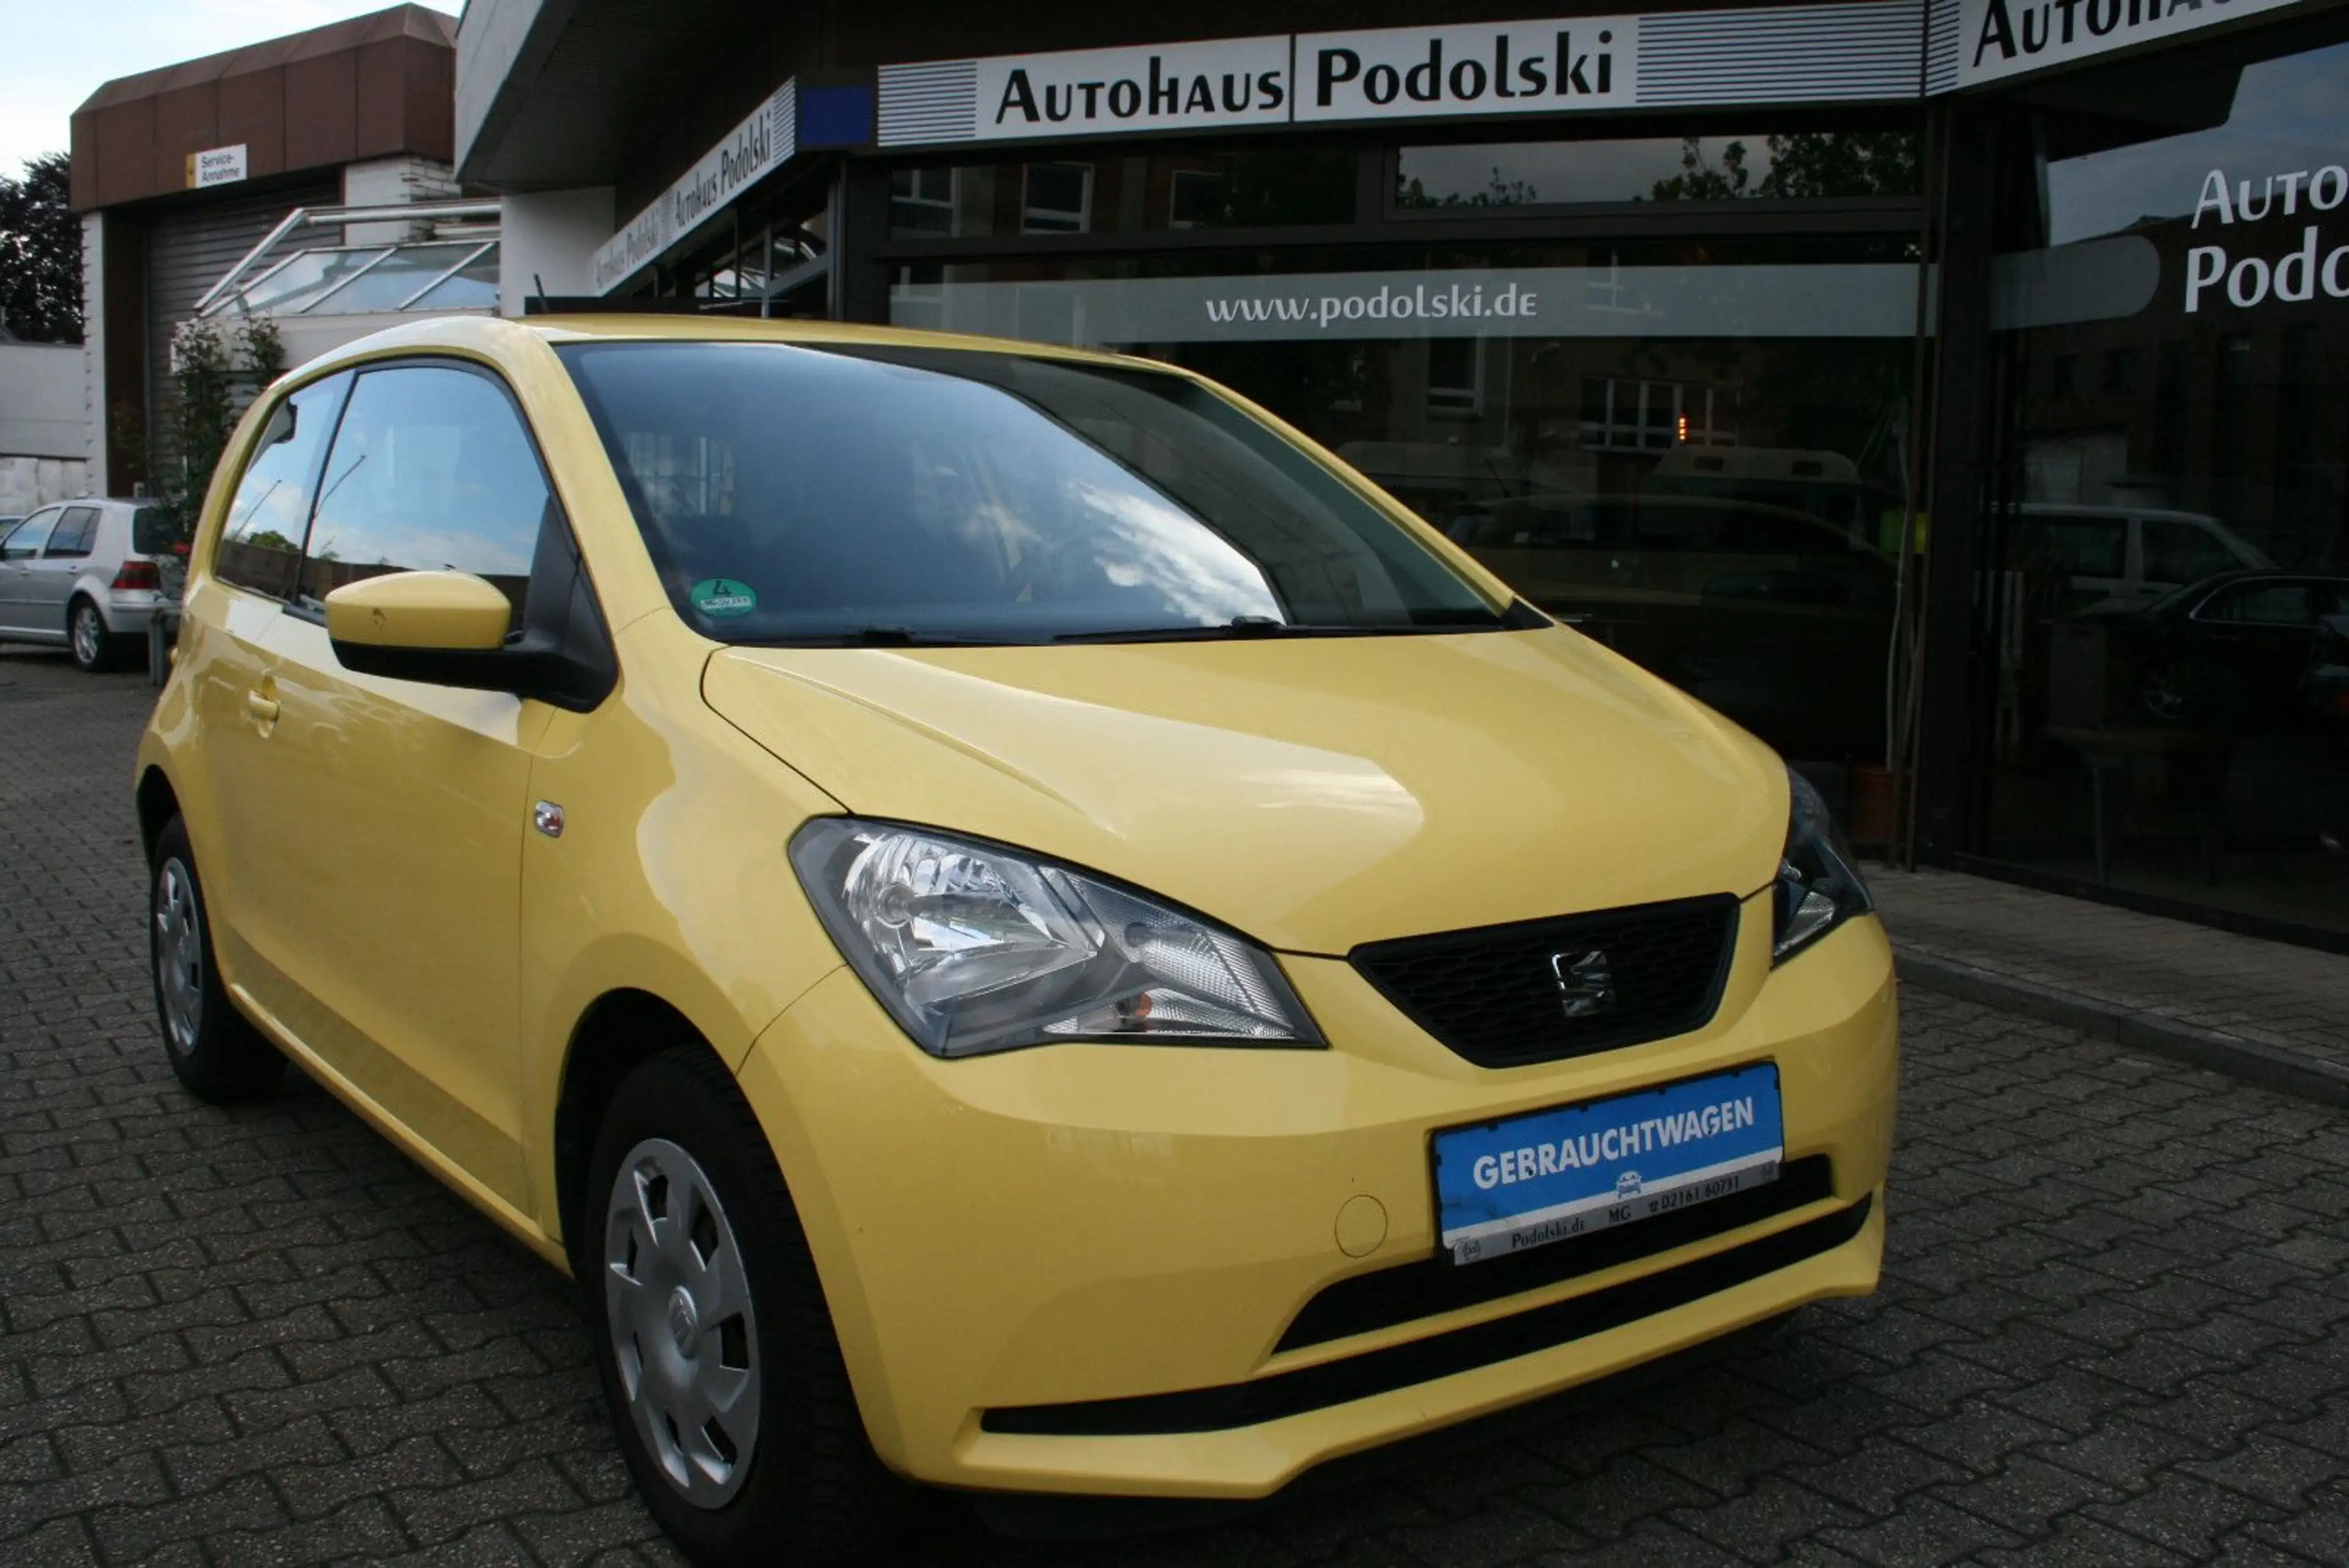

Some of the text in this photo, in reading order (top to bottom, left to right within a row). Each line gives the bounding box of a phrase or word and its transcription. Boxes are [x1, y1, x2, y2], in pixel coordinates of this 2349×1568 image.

[1317, 30, 1612, 106] Podolski
[721, 109, 770, 195] Podolski
[1206, 283, 1537, 328] www.podolski.de
[1474, 1097, 1754, 1189] GEBRAUCHTWAGEN
[1512, 1216, 1586, 1249] Podolski.de
[1608, 1205, 1631, 1224] MG
[1662, 1186, 1701, 1209] 02161
